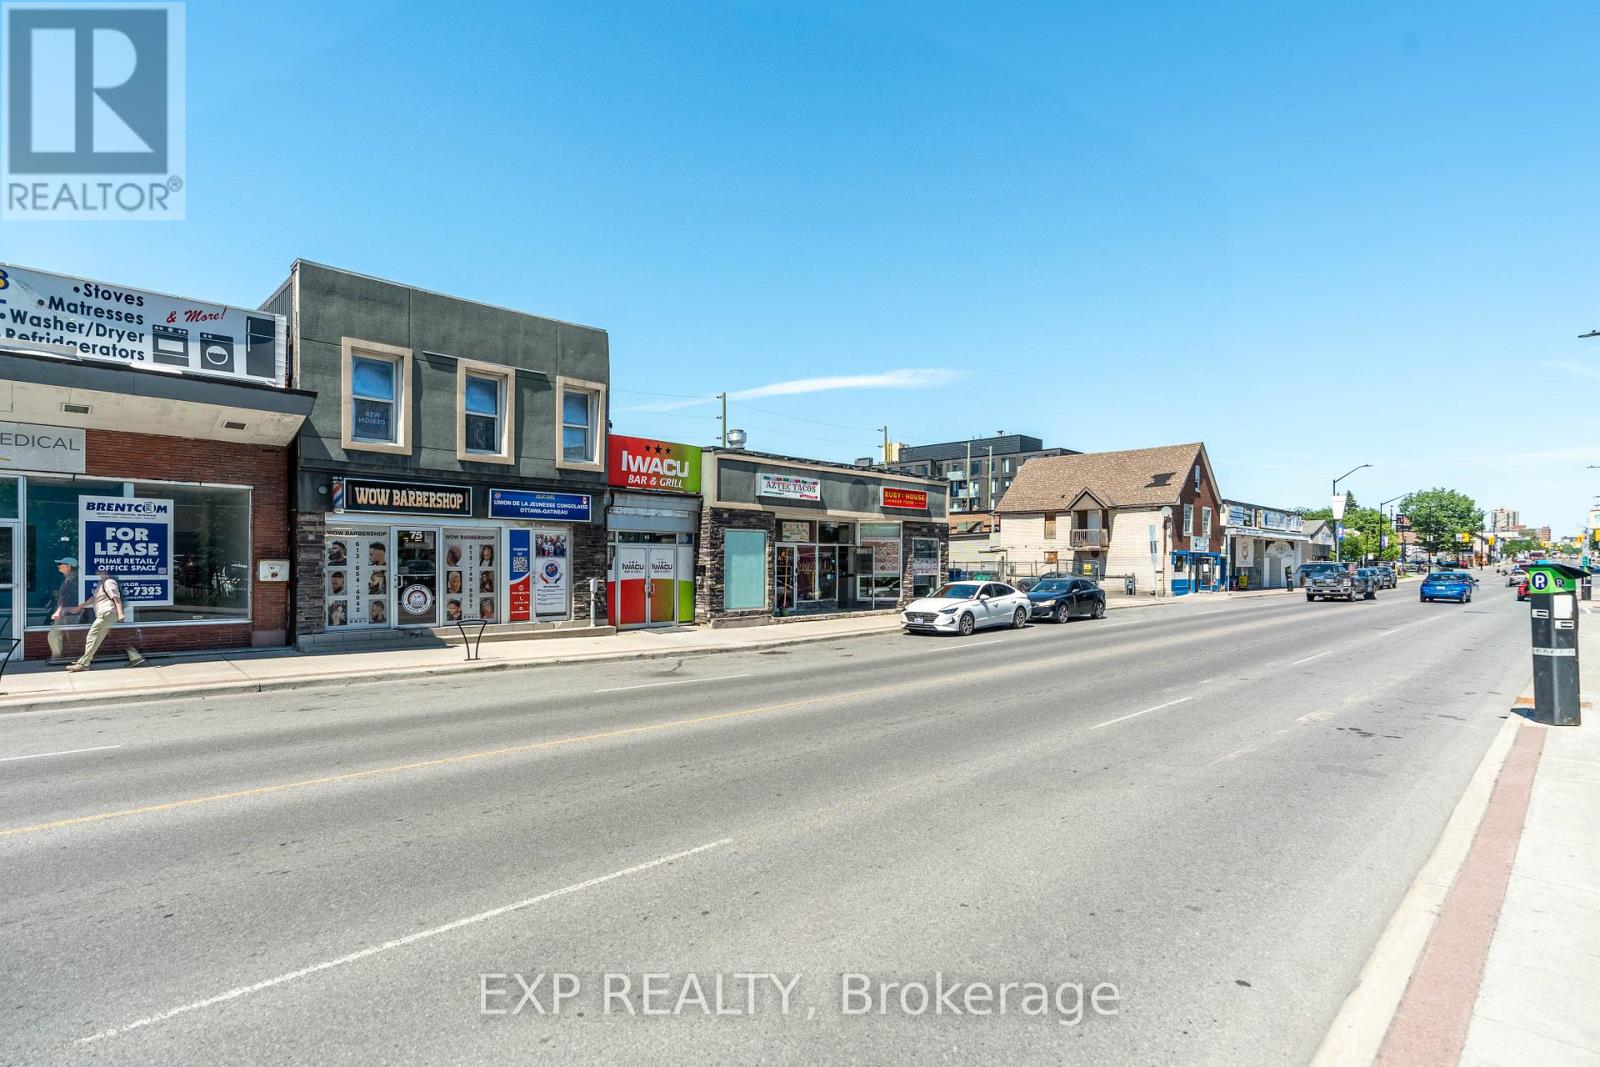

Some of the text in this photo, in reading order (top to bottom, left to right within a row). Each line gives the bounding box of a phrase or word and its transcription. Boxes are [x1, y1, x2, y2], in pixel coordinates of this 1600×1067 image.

[83, 282, 144, 307] Stoves
[47, 295, 144, 326] Matresses
[166, 307, 227, 323] & More!
[9, 308, 145, 343] Washer/Dryer
[621, 449, 690, 478] IWACU
[627, 474, 684, 489] BAR & GRILL
[766, 481, 791, 491] AZTEC
[793, 483, 816, 493] TACOS
[355, 486, 464, 510] WOW BARBERSHOP
[905, 493, 926, 501] HOUSE
[85, 501, 168, 514] BRENTCOM
[105, 527, 149, 541] FOR
[94, 542, 159, 556] LEASE
[94, 557, 122, 565] PRIME
